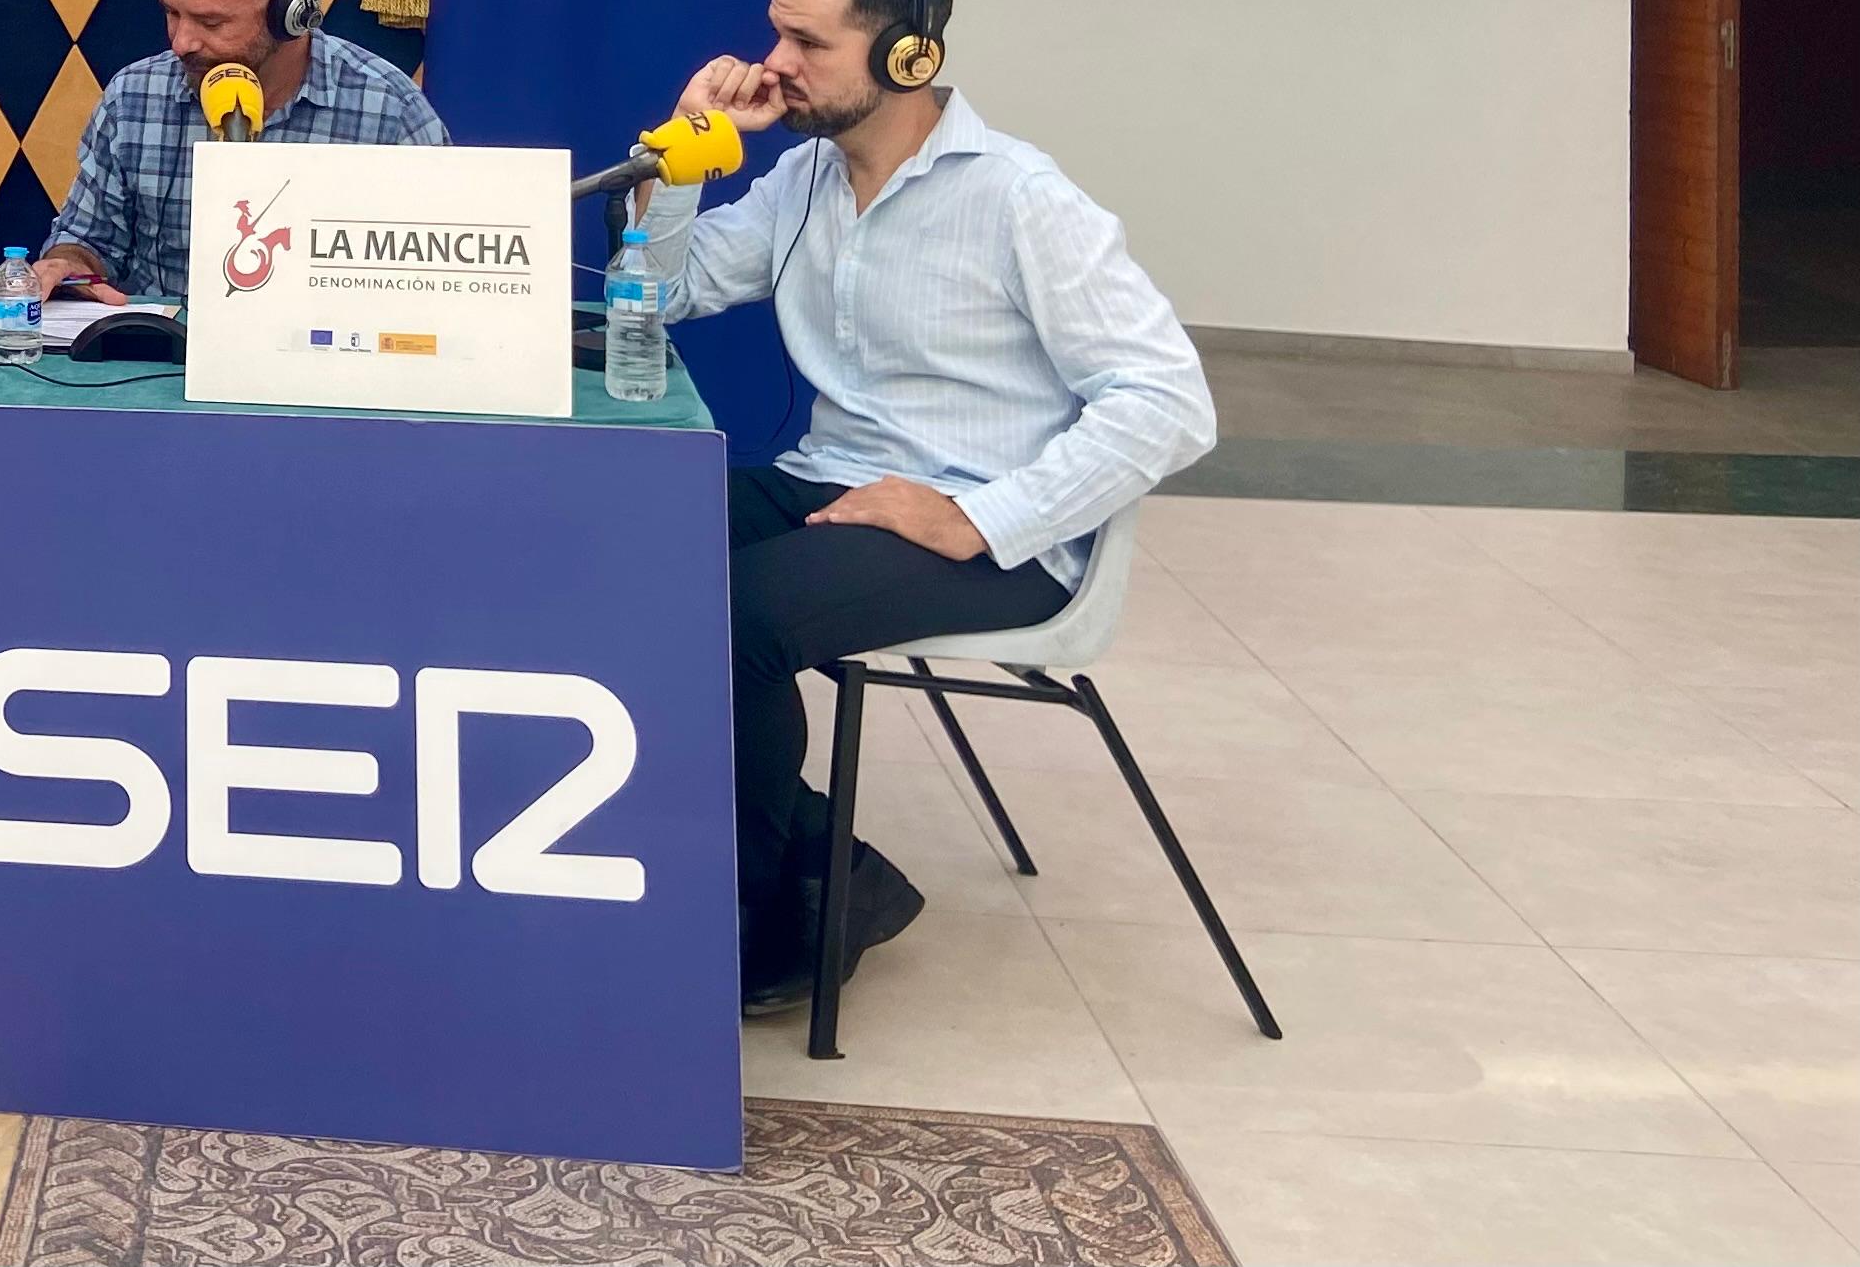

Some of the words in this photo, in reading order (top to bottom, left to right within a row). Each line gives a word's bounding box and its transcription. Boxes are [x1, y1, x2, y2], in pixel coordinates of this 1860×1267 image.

[207, 67, 260, 88] SER
[310, 229, 353, 260] LA
[364, 230, 530, 266] MANCHA
[309, 275, 436, 291] DENOMINACIÓN
[442, 281, 462, 293] DE
[469, 282, 531, 295] ORIGEN
